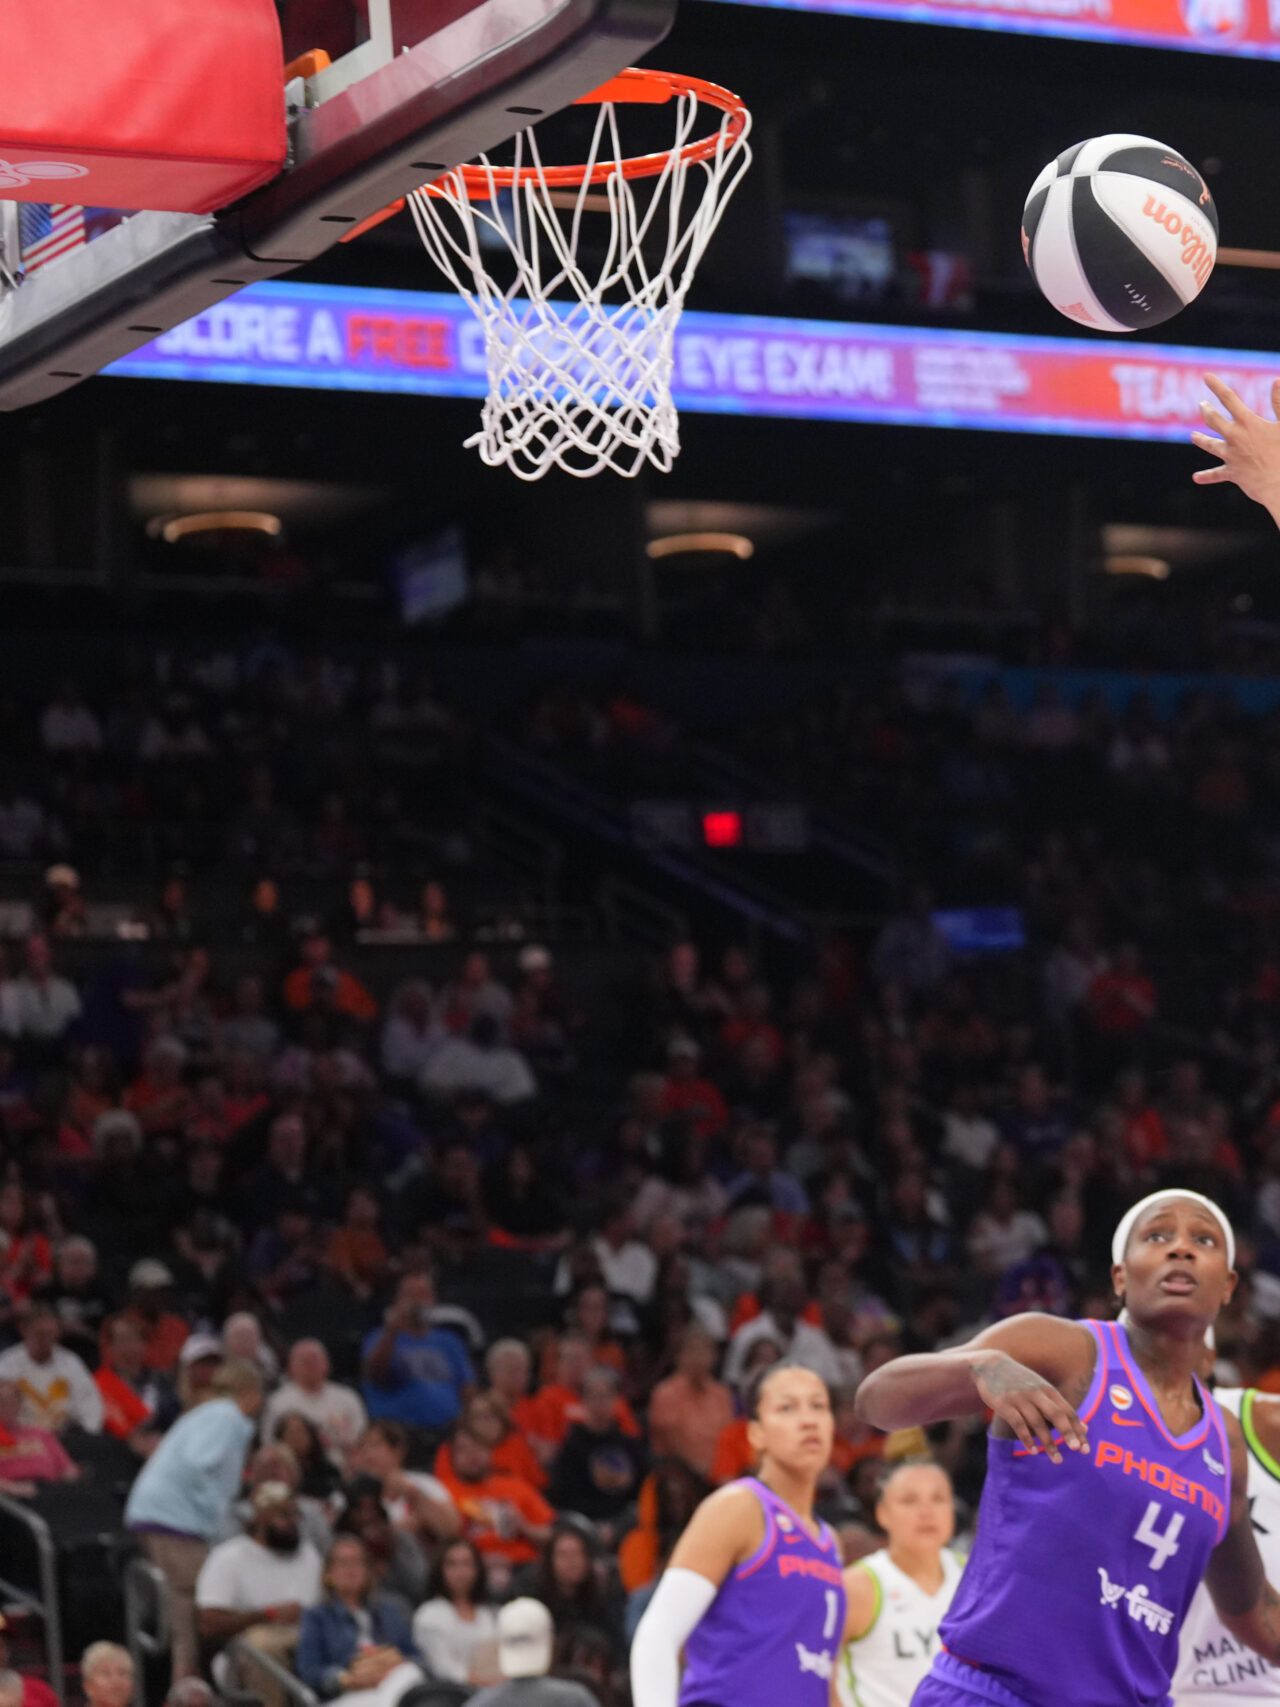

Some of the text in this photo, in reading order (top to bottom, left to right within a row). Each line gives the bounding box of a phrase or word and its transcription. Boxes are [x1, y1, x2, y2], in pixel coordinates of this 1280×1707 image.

[1141, 192, 1214, 290] Wilson
[305, 307, 343, 366] A
[344, 313, 453, 369] FREE
[678, 333, 765, 393] EYE
[764, 339, 893, 399] EXAM!
[1095, 1440, 1226, 1521] PHOENIX
[1133, 1500, 1186, 1572] 4
[822, 1589, 837, 1640] 1
[893, 1628, 934, 1659] LY
[1193, 1636, 1246, 1664] MA
[1193, 1655, 1269, 1687] CLINI
